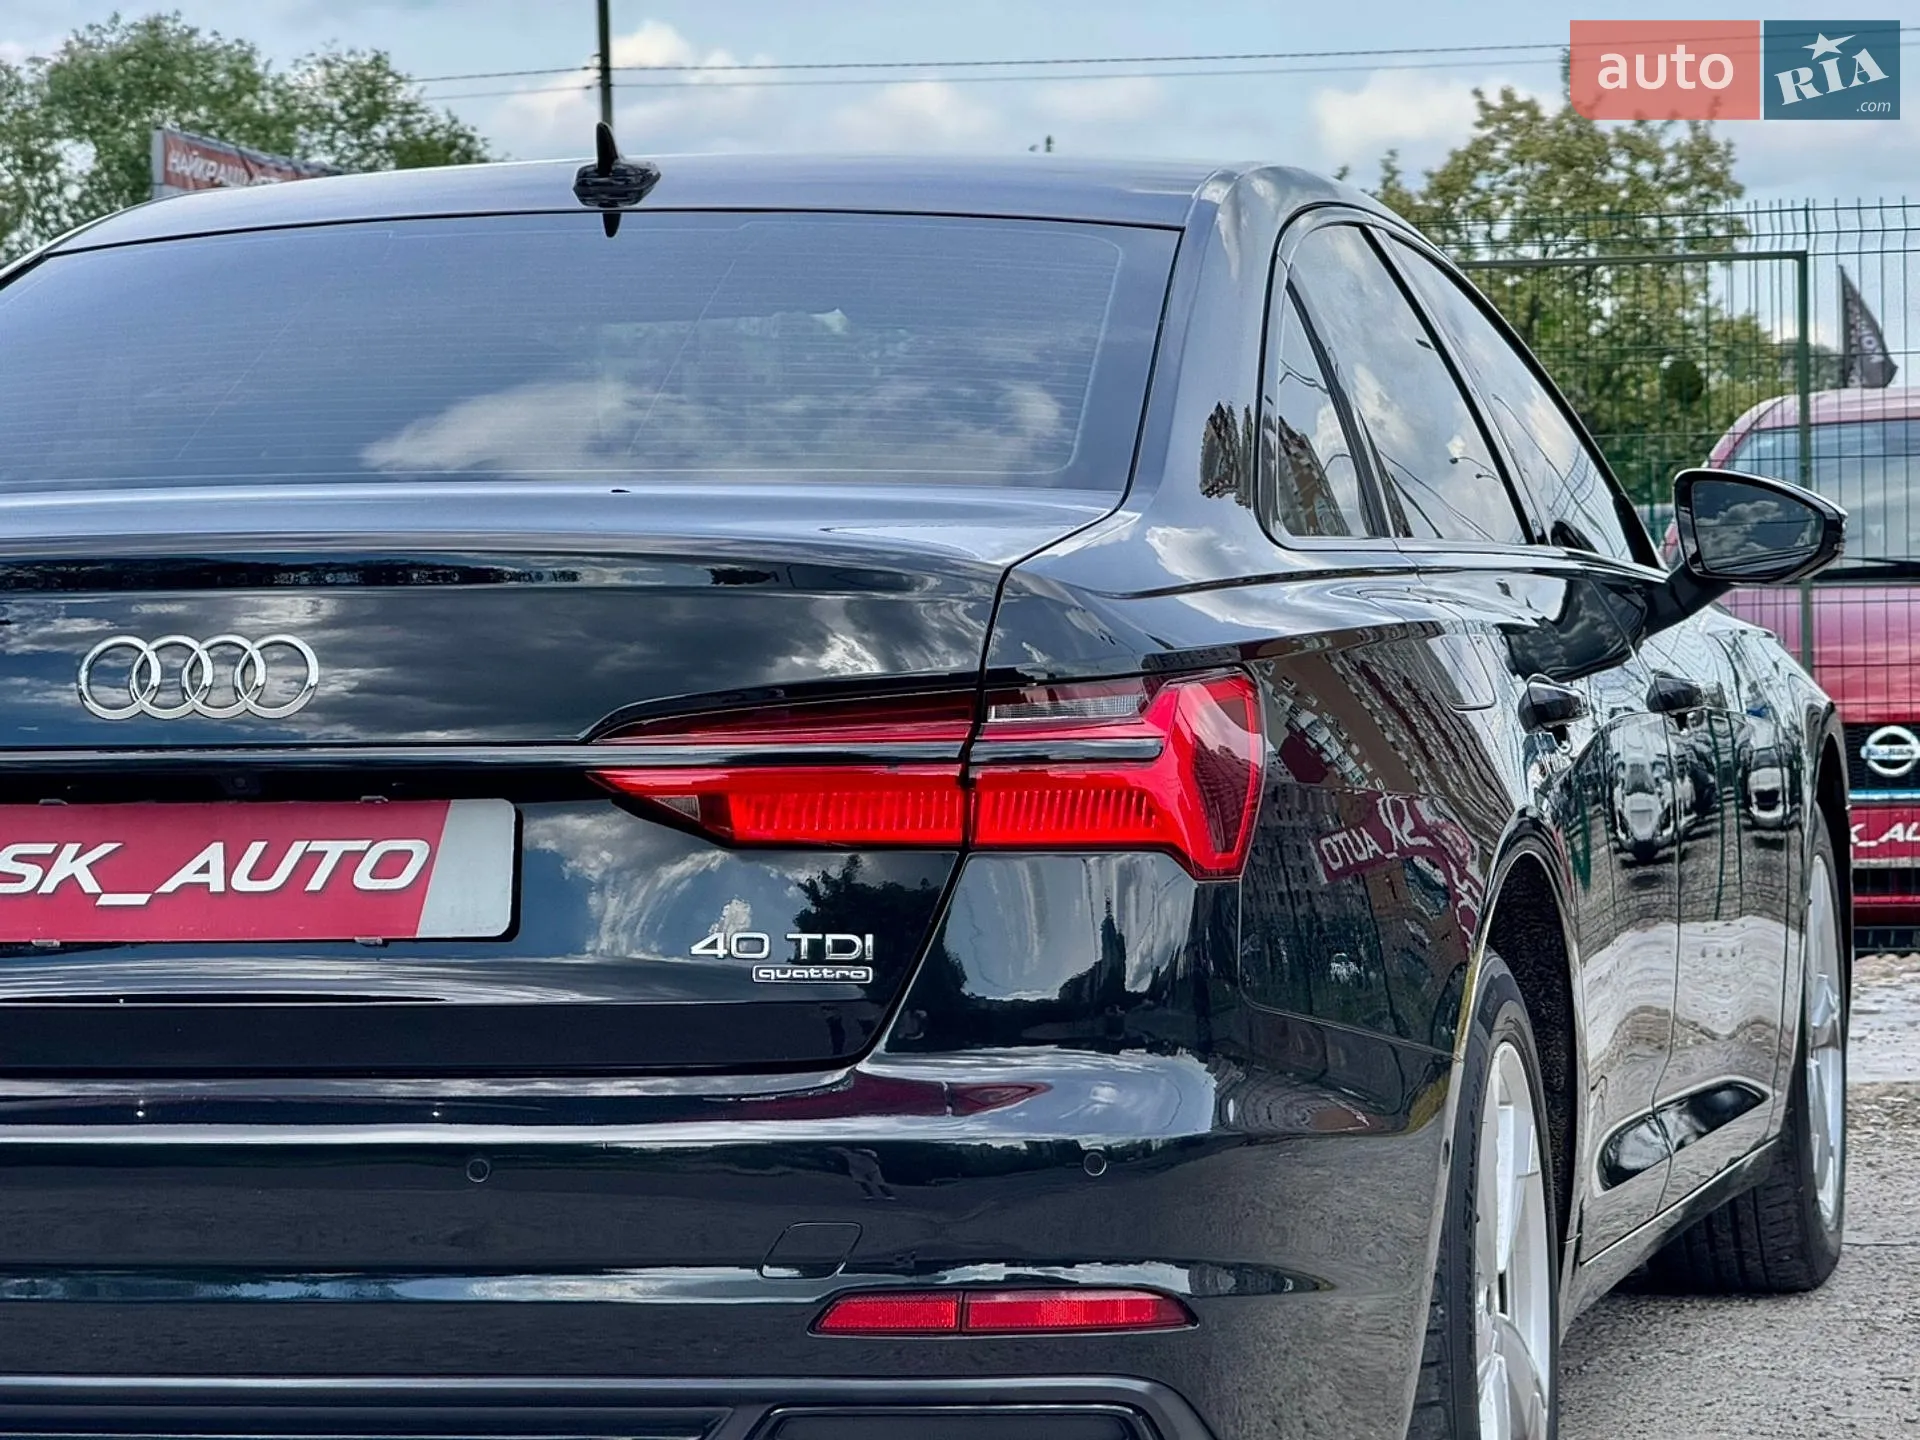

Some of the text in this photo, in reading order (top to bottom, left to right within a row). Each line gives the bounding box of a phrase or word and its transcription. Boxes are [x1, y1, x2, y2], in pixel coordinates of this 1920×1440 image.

[691, 932, 874, 960] 40 TDI
[758, 968, 866, 981] quattro
